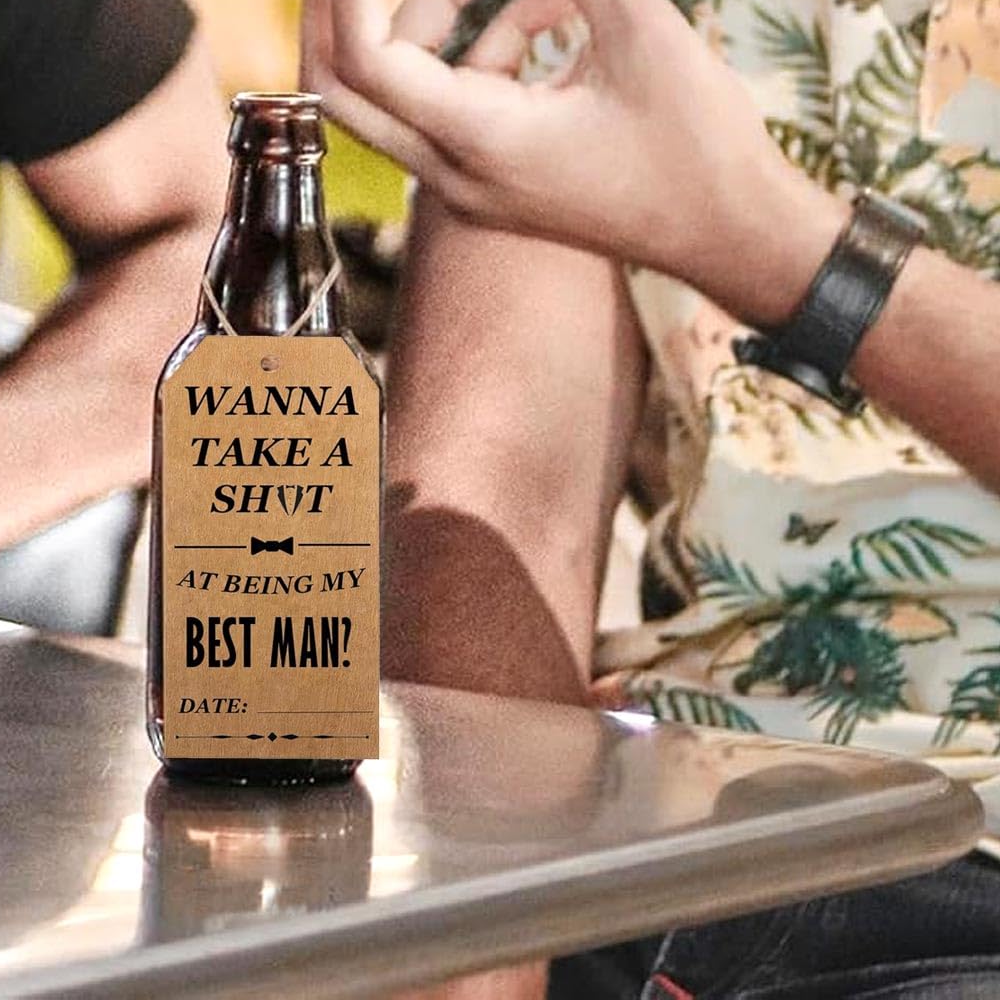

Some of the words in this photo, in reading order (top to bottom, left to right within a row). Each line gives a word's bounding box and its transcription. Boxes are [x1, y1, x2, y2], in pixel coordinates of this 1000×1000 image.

[184, 385, 359, 416] WANNA
[191, 437, 313, 467] TAKE
[319, 437, 353, 467] A
[210, 484, 334, 516] SHT
[175, 569, 219, 591] AT
[221, 574, 314, 595] BEING
[319, 567, 367, 593] MY
[185, 616, 257, 668] BEST
[269, 616, 352, 668] MAN?
[177, 697, 248, 714] DATE:
